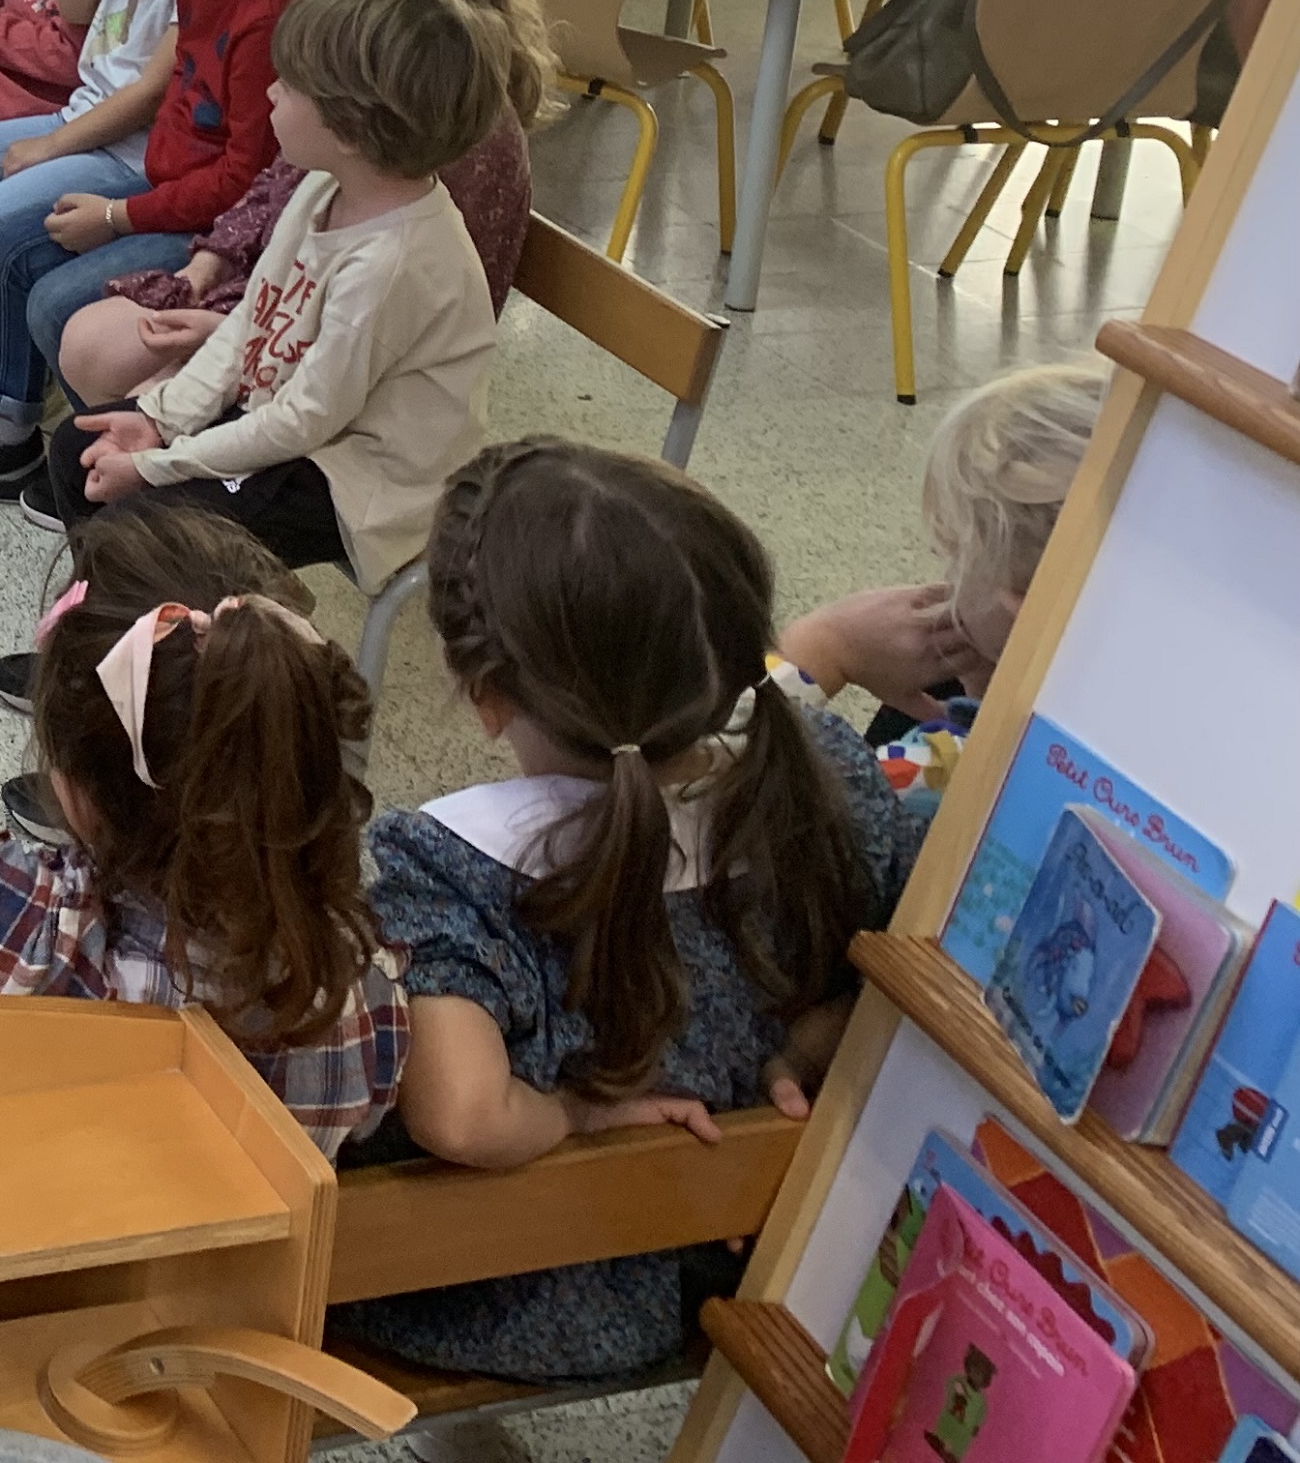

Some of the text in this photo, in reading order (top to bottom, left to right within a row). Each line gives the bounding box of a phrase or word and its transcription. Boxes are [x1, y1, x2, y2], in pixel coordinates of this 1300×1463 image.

[1046, 743, 1200, 874] Petit Ours Brun
